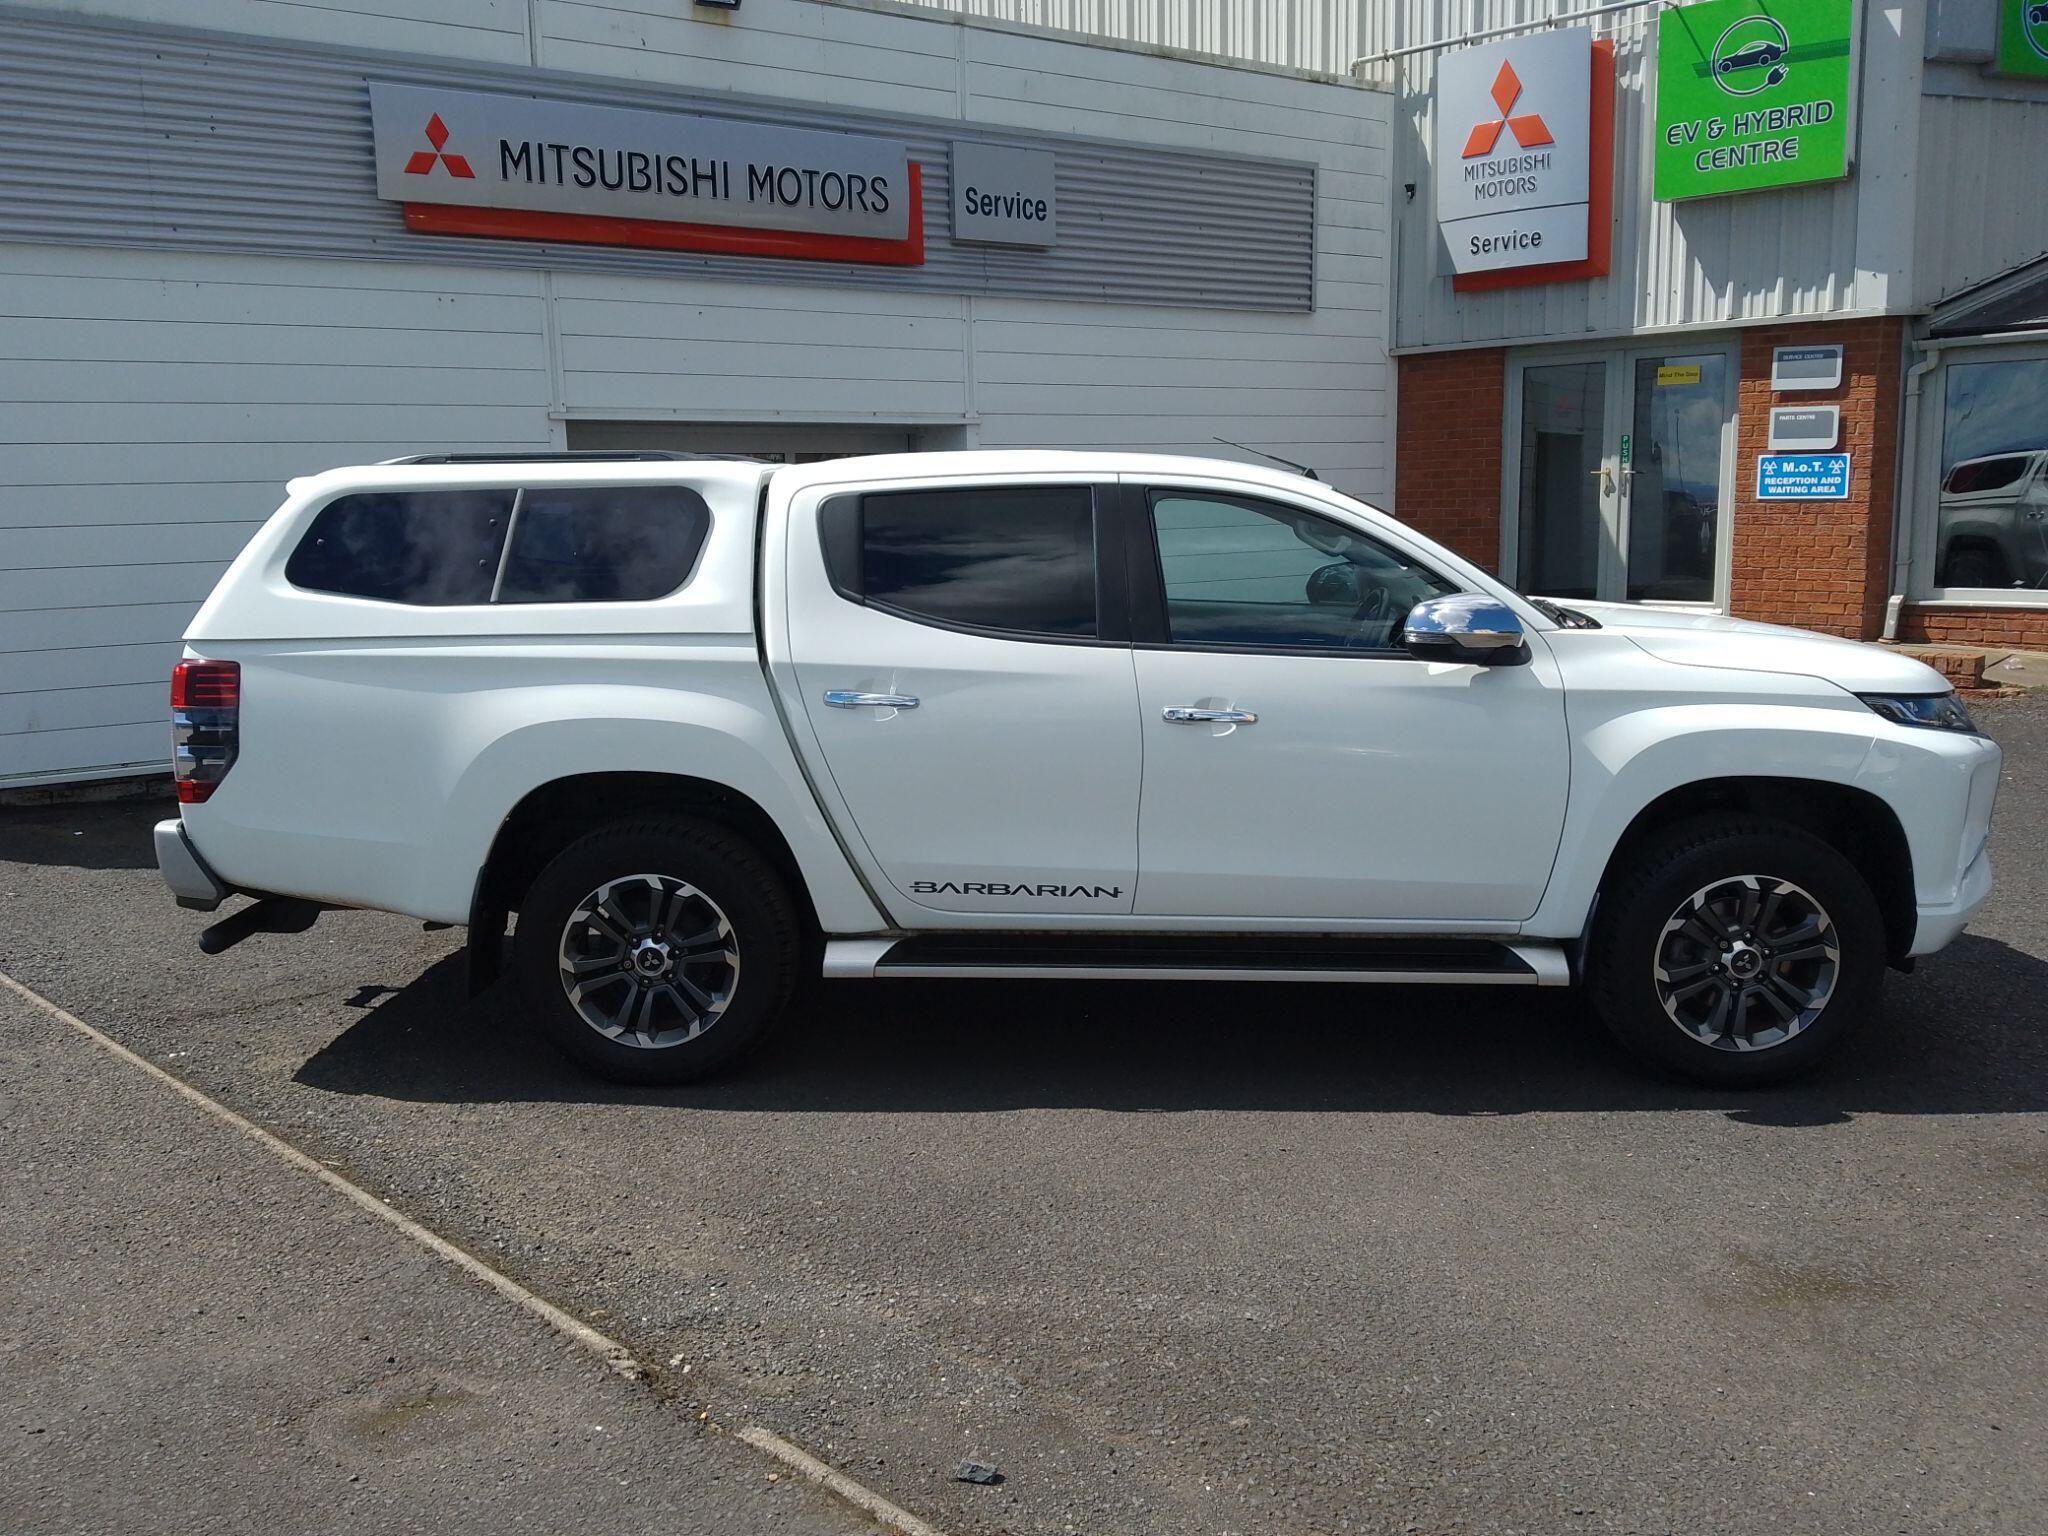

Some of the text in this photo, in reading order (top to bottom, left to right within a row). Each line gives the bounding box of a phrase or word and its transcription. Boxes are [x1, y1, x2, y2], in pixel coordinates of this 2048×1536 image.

[1666, 100, 1834, 146] EV & HYBRID
[1463, 152, 1552, 182] MITSUBISHI
[1694, 137, 1799, 171] CENTRE
[499, 138, 889, 215] MITSUBISHI MOTORS
[1474, 174, 1538, 200] MOTORS
[965, 185, 1049, 222] Service
[1470, 228, 1543, 255] Service
[1764, 476, 1842, 485] RECEPTION AND
[1782, 461, 1824, 473] M.o.T.
[1810, 485, 1836, 493] AREA
[909, 881, 1124, 899] BARBARIAN
